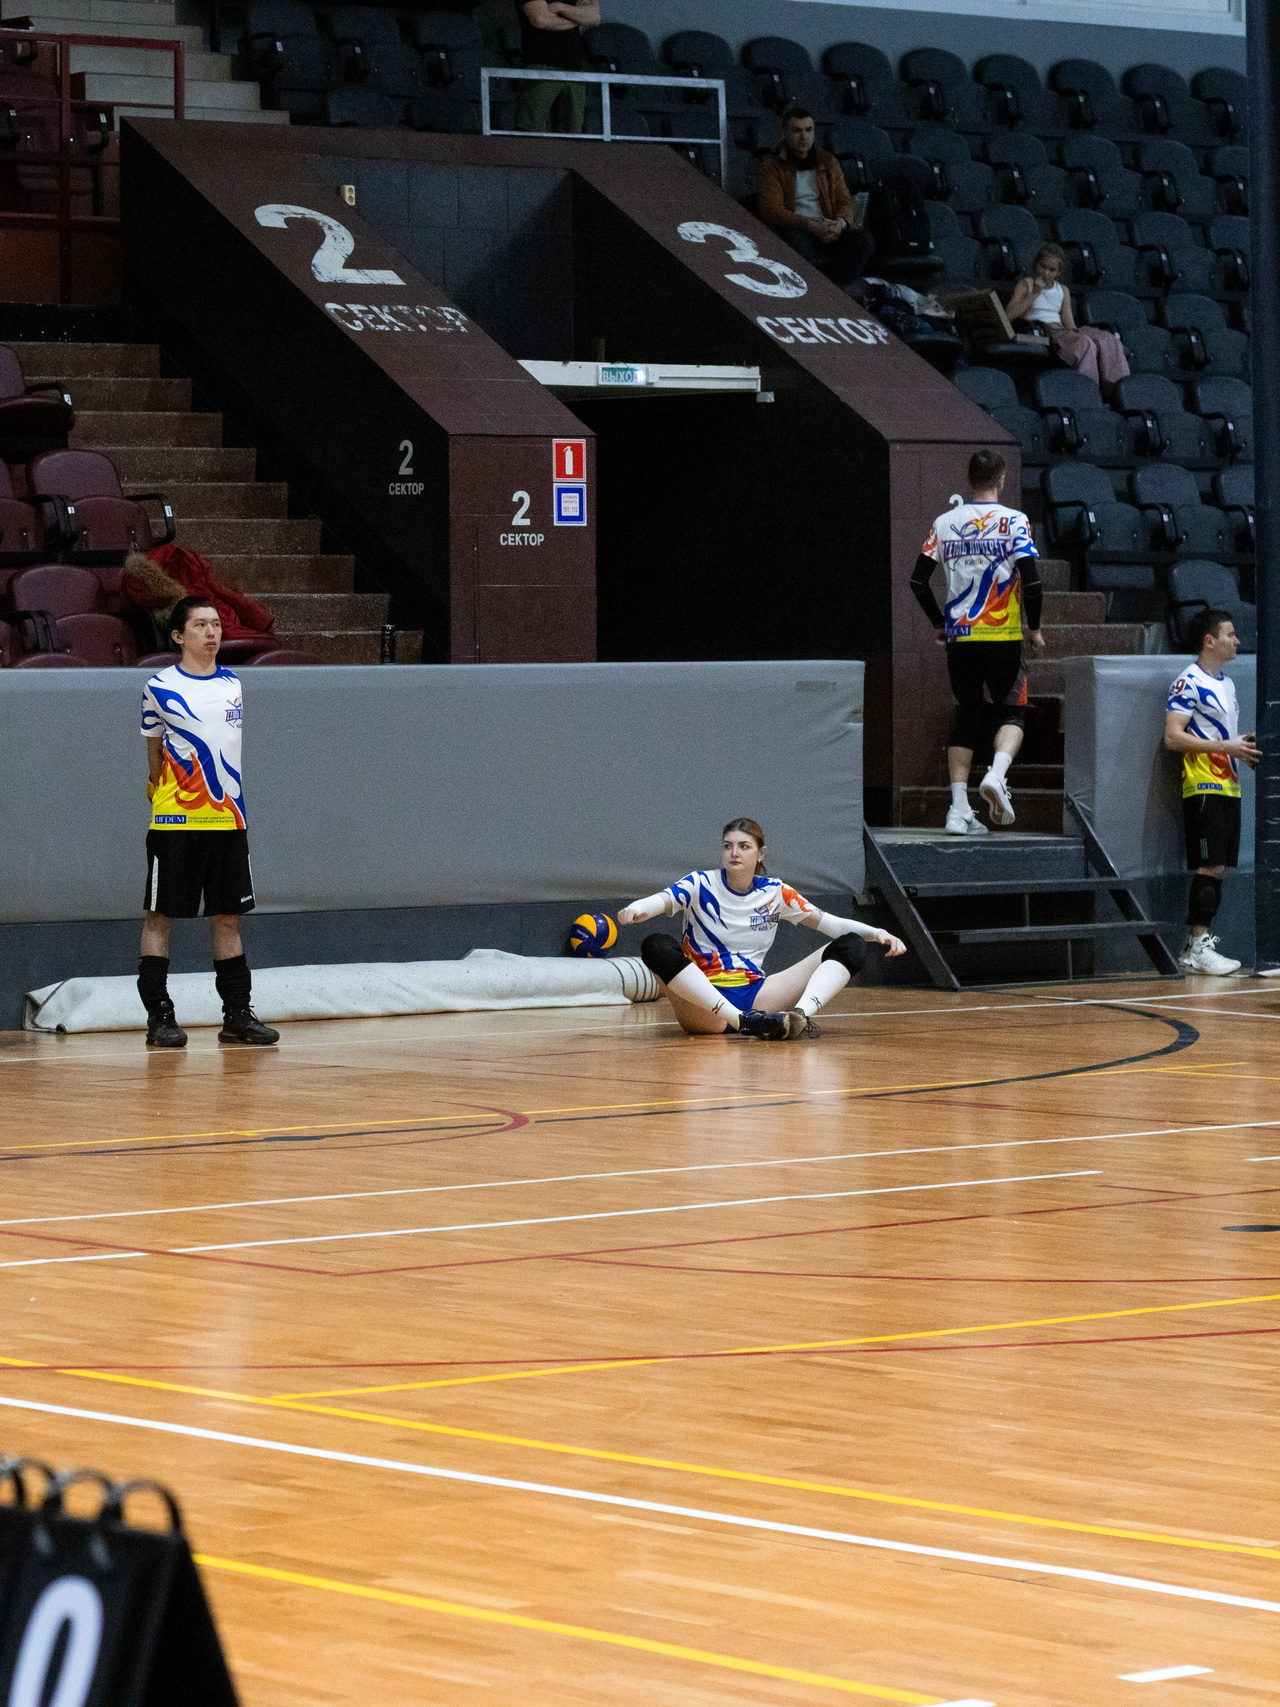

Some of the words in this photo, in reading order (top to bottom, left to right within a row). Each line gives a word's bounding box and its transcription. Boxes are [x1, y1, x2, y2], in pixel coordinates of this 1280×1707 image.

[254, 203, 407, 285] 2
[677, 221, 808, 299] 3
[756, 316, 890, 345] СЕКТОР
[398, 439, 414, 475] 2
[388, 482, 425, 495] СЕКТОР
[511, 490, 531, 526] 2
[998, 516, 1010, 535] 8
[499, 533, 545, 546] СЕКТОР
[8, 1575, 104, 1707] 0
